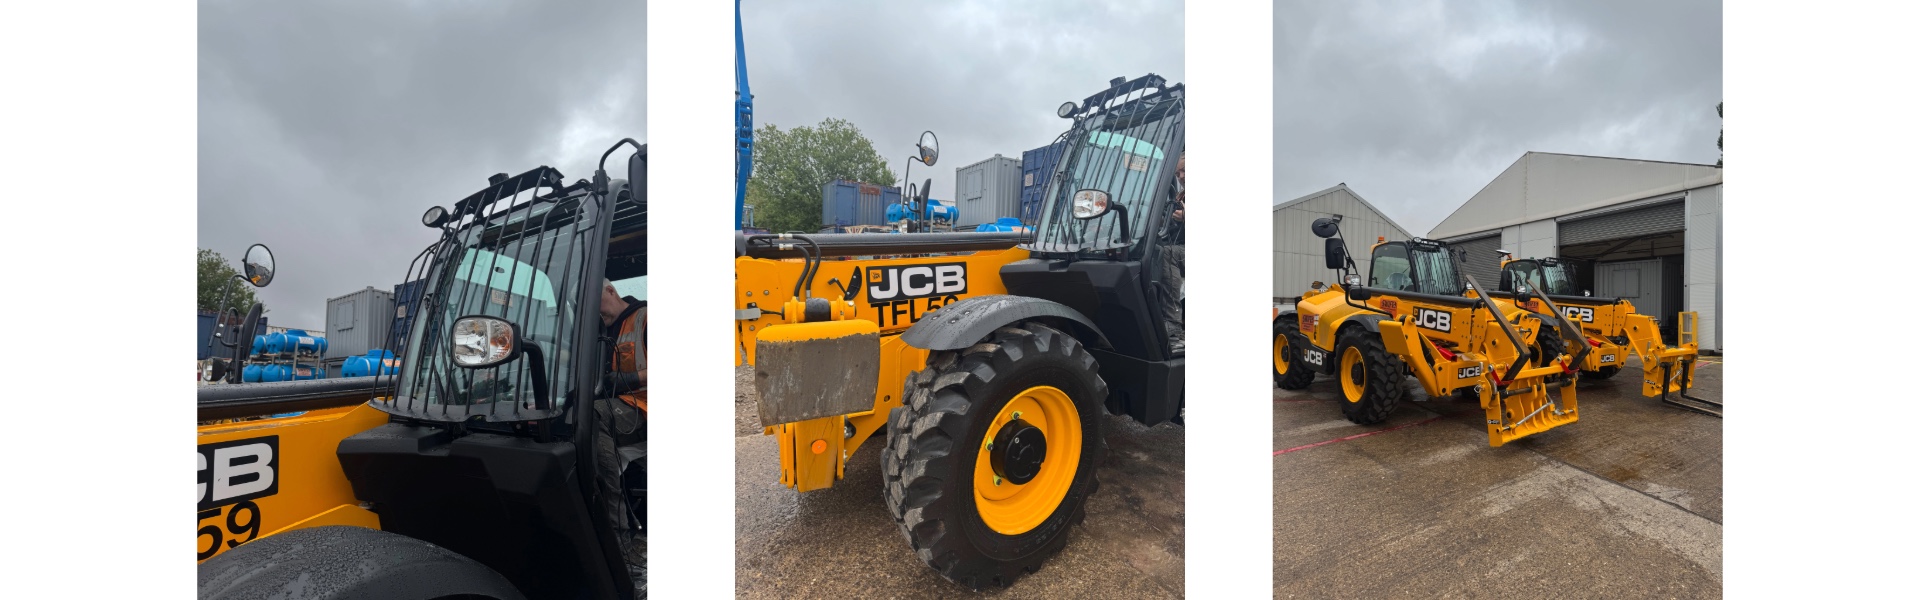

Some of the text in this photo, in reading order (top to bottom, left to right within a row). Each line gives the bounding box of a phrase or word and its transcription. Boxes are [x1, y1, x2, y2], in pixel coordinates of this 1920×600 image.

[870, 265, 966, 299] JCB
[870, 300, 922, 328] TFL
[1415, 308, 1451, 331] JCB
[1304, 349, 1322, 366] JCB
